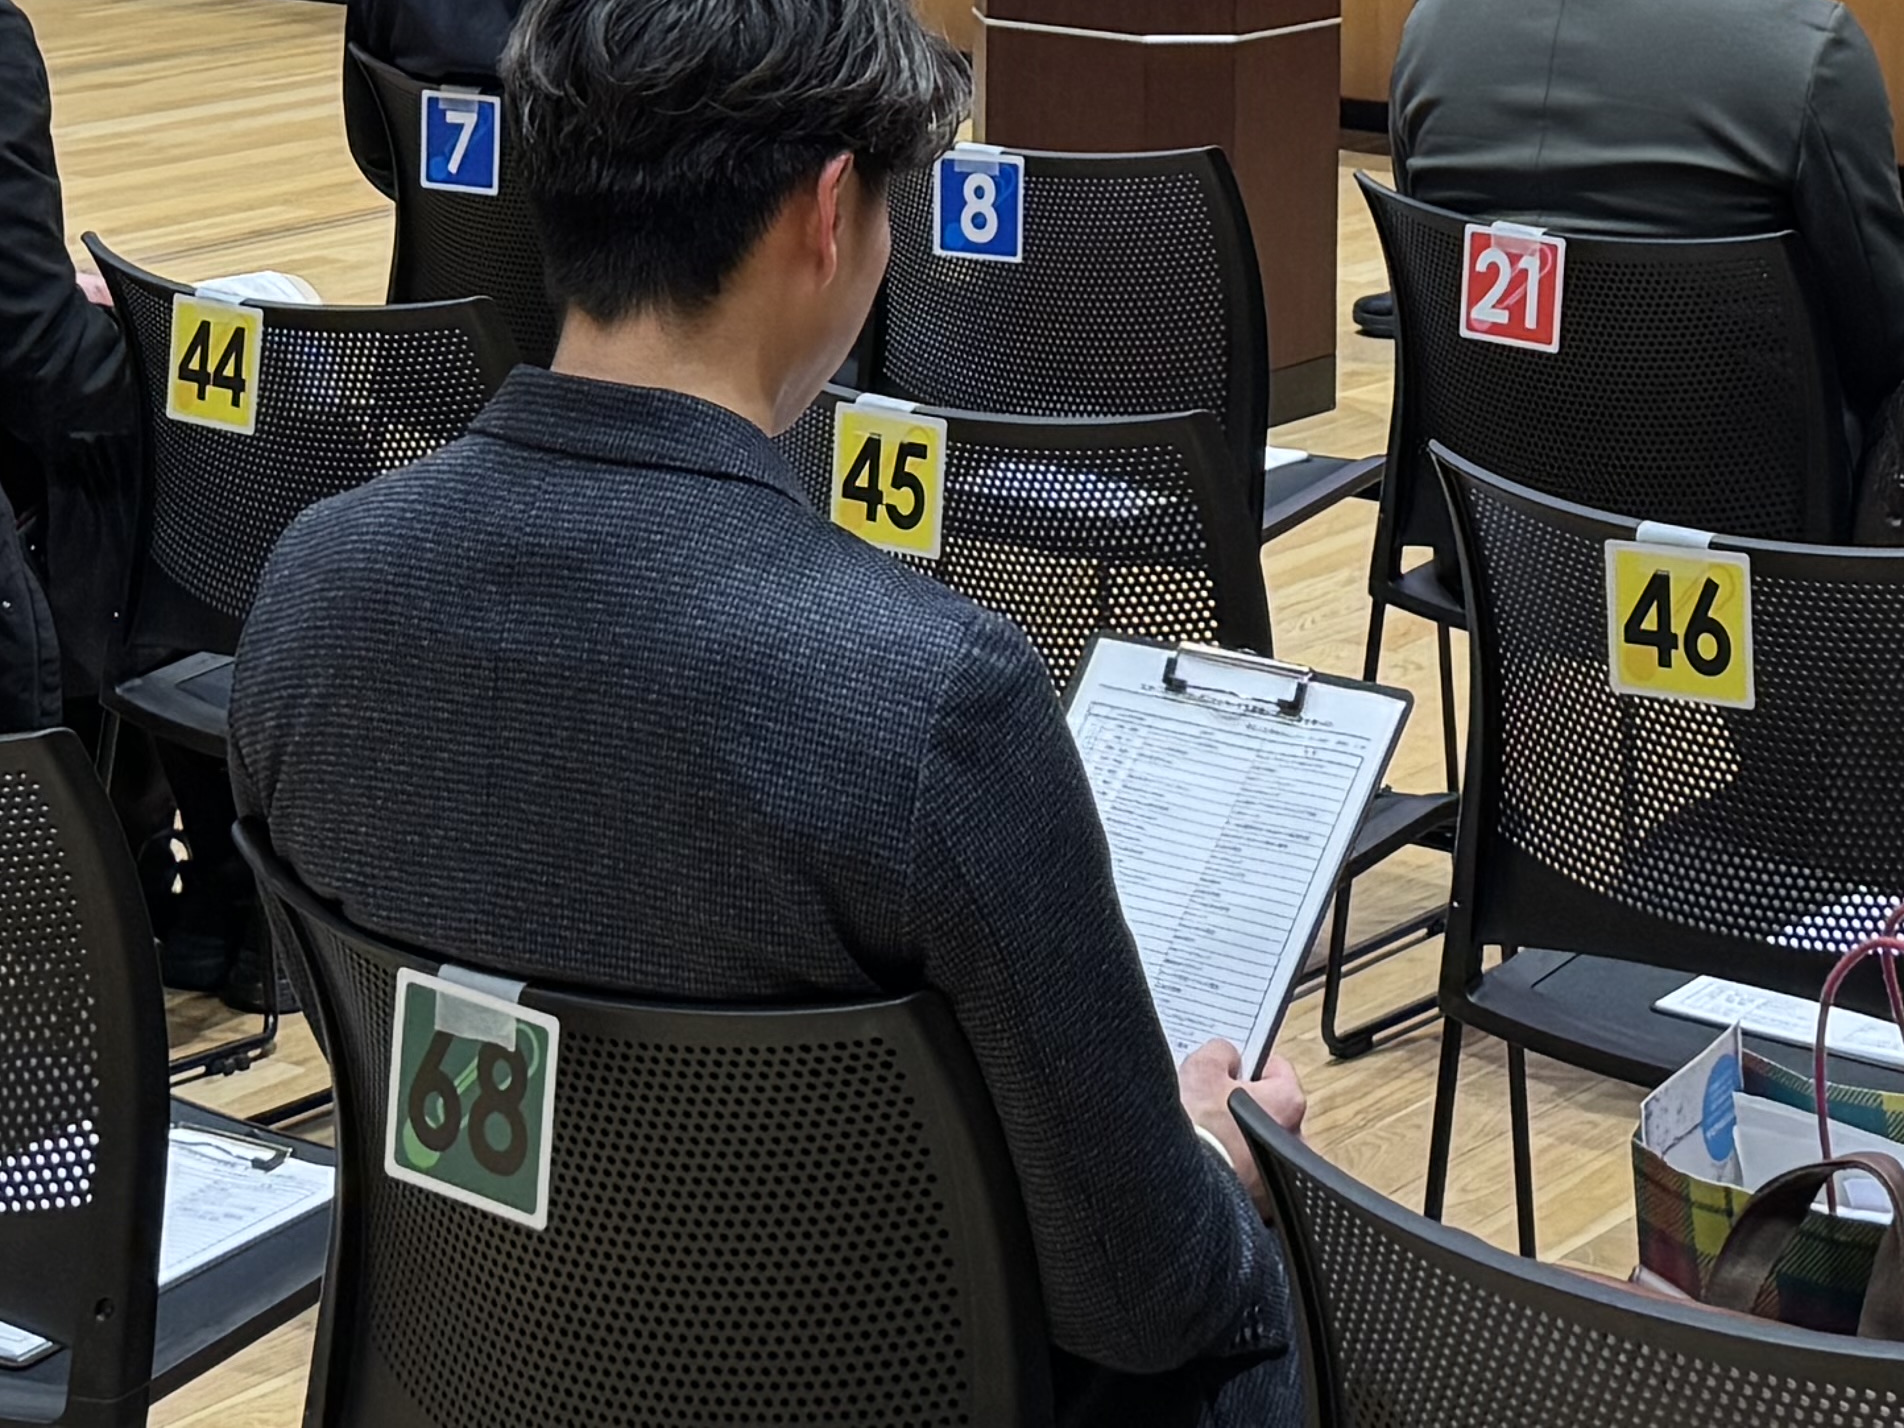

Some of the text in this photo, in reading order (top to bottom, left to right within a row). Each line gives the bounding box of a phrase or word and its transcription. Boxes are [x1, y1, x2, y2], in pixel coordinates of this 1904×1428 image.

[443, 110, 479, 174] 7
[959, 171, 999, 244] 8
[1470, 246, 1542, 331] 21
[177, 319, 248, 407] 44
[840, 435, 927, 531] 45
[1622, 569, 1733, 677] 46
[408, 1030, 529, 1177] 68
